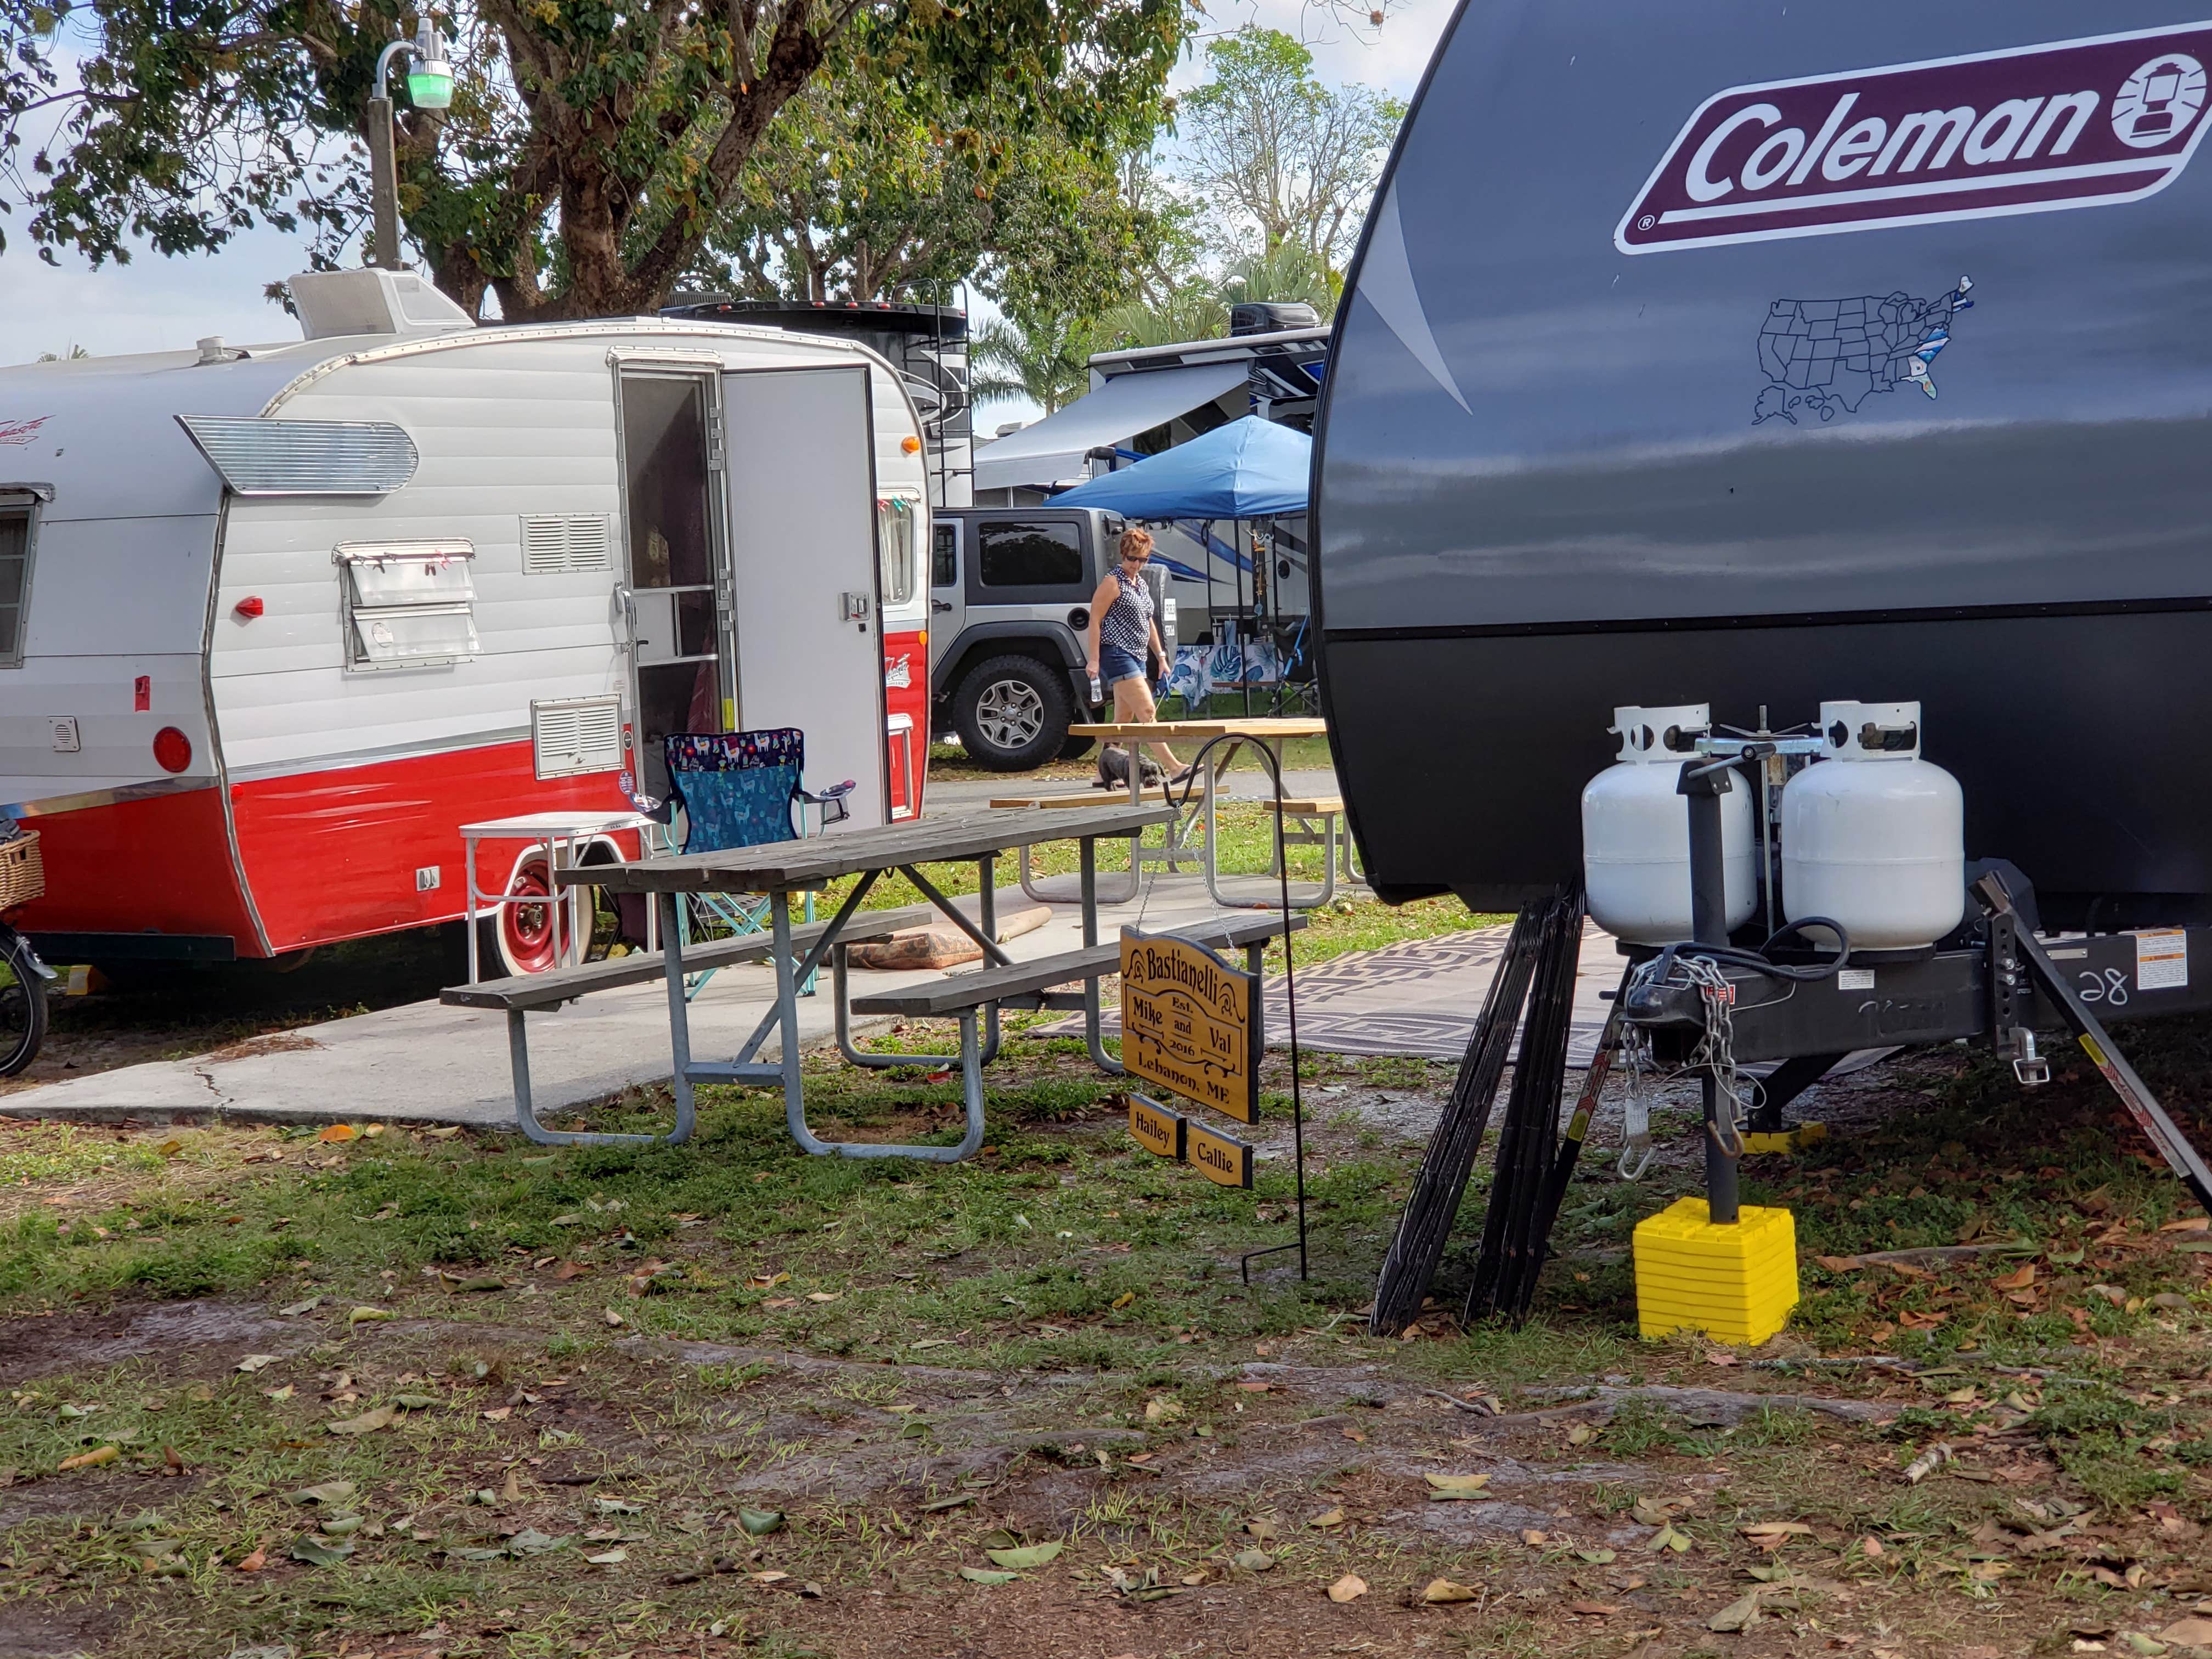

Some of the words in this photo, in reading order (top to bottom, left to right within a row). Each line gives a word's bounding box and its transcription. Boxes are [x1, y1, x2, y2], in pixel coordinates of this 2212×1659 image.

[1686, 90, 2100, 202] Coleman
[1146, 948, 1218, 1006] Bastianelli
[2079, 968, 2128, 1006] 28
[1172, 997, 1193, 1013] Est.
[1133, 996, 1163, 1027] Mike
[1174, 1020, 1192, 1034] and
[1210, 1026, 1231, 1054] Val
[1170, 1040, 1195, 1056] 2016
[1138, 1052, 1200, 1093] Lebanon,
[1207, 1081, 1229, 1104] ME
[1136, 1111, 1170, 1149] Hailey
[1198, 1143, 1233, 1173] Callie
